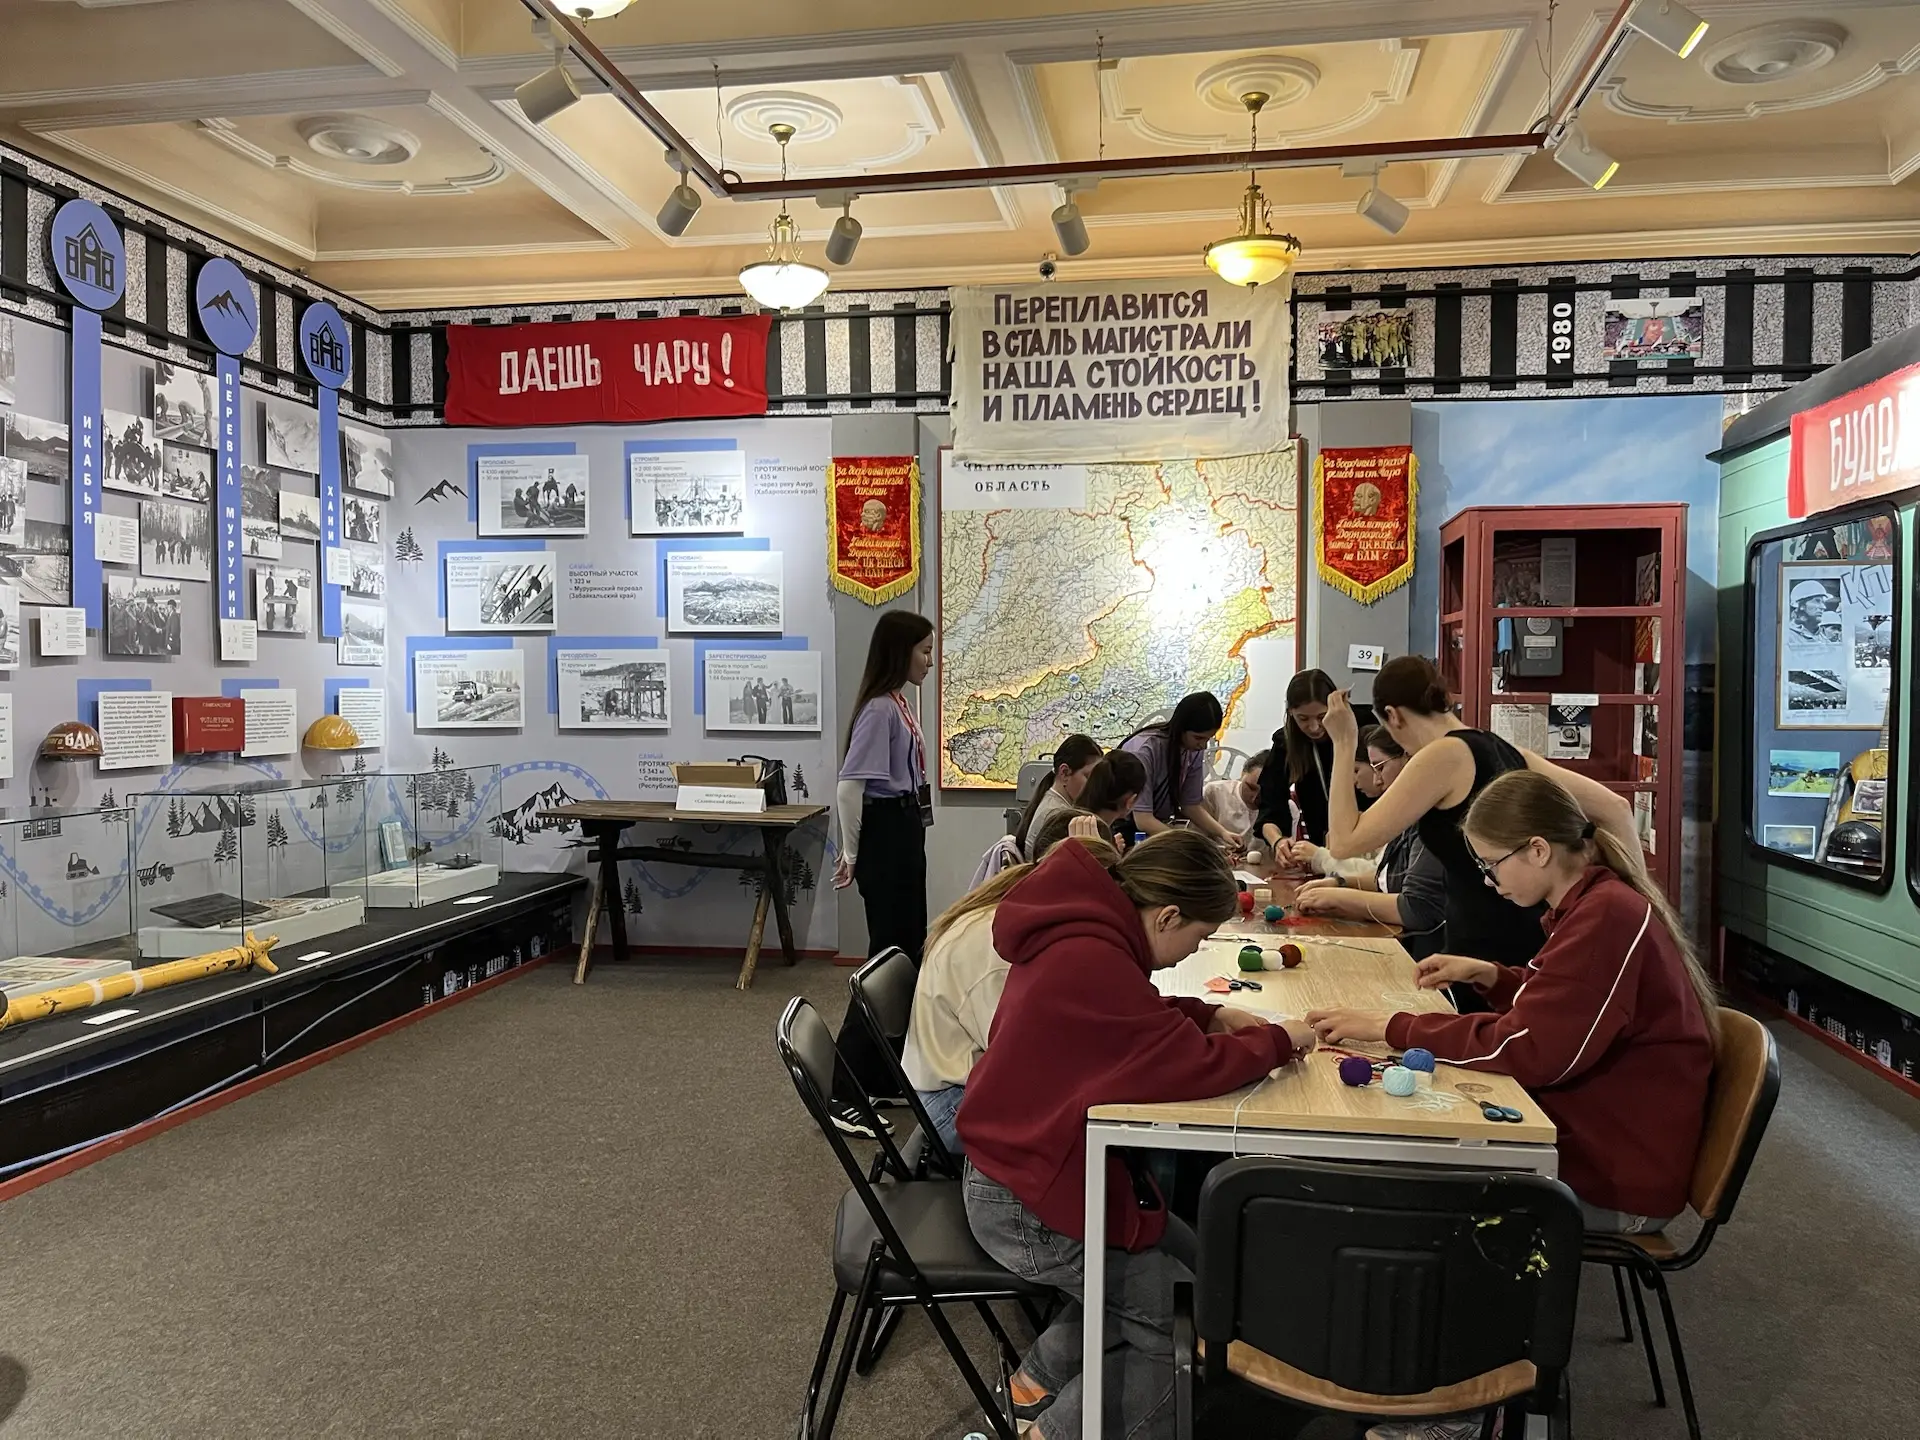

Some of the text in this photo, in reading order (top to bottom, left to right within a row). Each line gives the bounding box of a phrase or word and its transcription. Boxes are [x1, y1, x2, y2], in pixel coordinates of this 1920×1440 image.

[993, 289, 1208, 326] ПЕРЕПЛАВИТСЯ
[982, 320, 1252, 358] В СТАЛЬ МАГИСТРАЛИ
[1551, 302, 1572, 365] 1980
[498, 343, 603, 396] ДАЕШЬ
[982, 352, 1256, 390] НАША СТОЙКОСТЬ
[982, 395, 1002, 422] И
[1012, 393, 1143, 421] ПЛАМЕНЬ
[224, 372, 234, 486] ПЕРЕВАЛ
[82, 415, 93, 525] ИКАБЬЯ
[754, 465, 807, 473] ПРОТЯЖЕННЫЙ
[795, 481, 813, 489] Амур
[975, 480, 1050, 492] ОБЛАСТЬ
[326, 485, 335, 541] ХАНИ
[569, 569, 607, 577] ВЫСОТНЫЙ
[1357, 649, 1372, 660] 39
